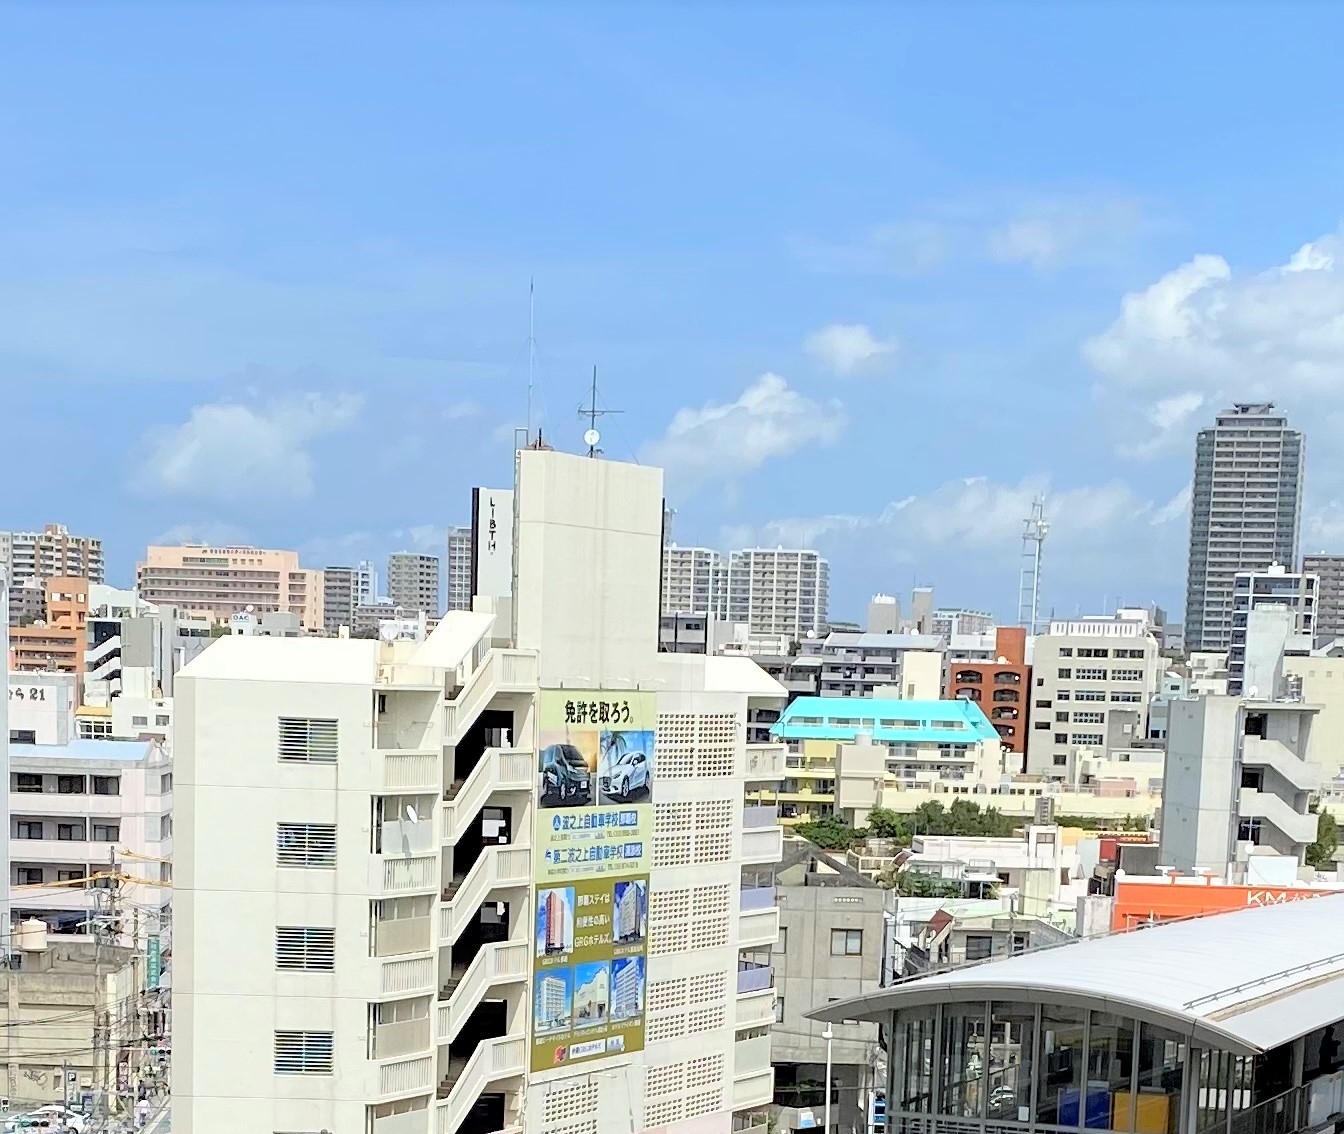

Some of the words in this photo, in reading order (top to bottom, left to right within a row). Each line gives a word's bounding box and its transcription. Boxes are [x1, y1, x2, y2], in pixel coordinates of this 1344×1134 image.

[30, 687, 45, 701] 21
[565, 700, 634, 724] 免許を取ろう。
